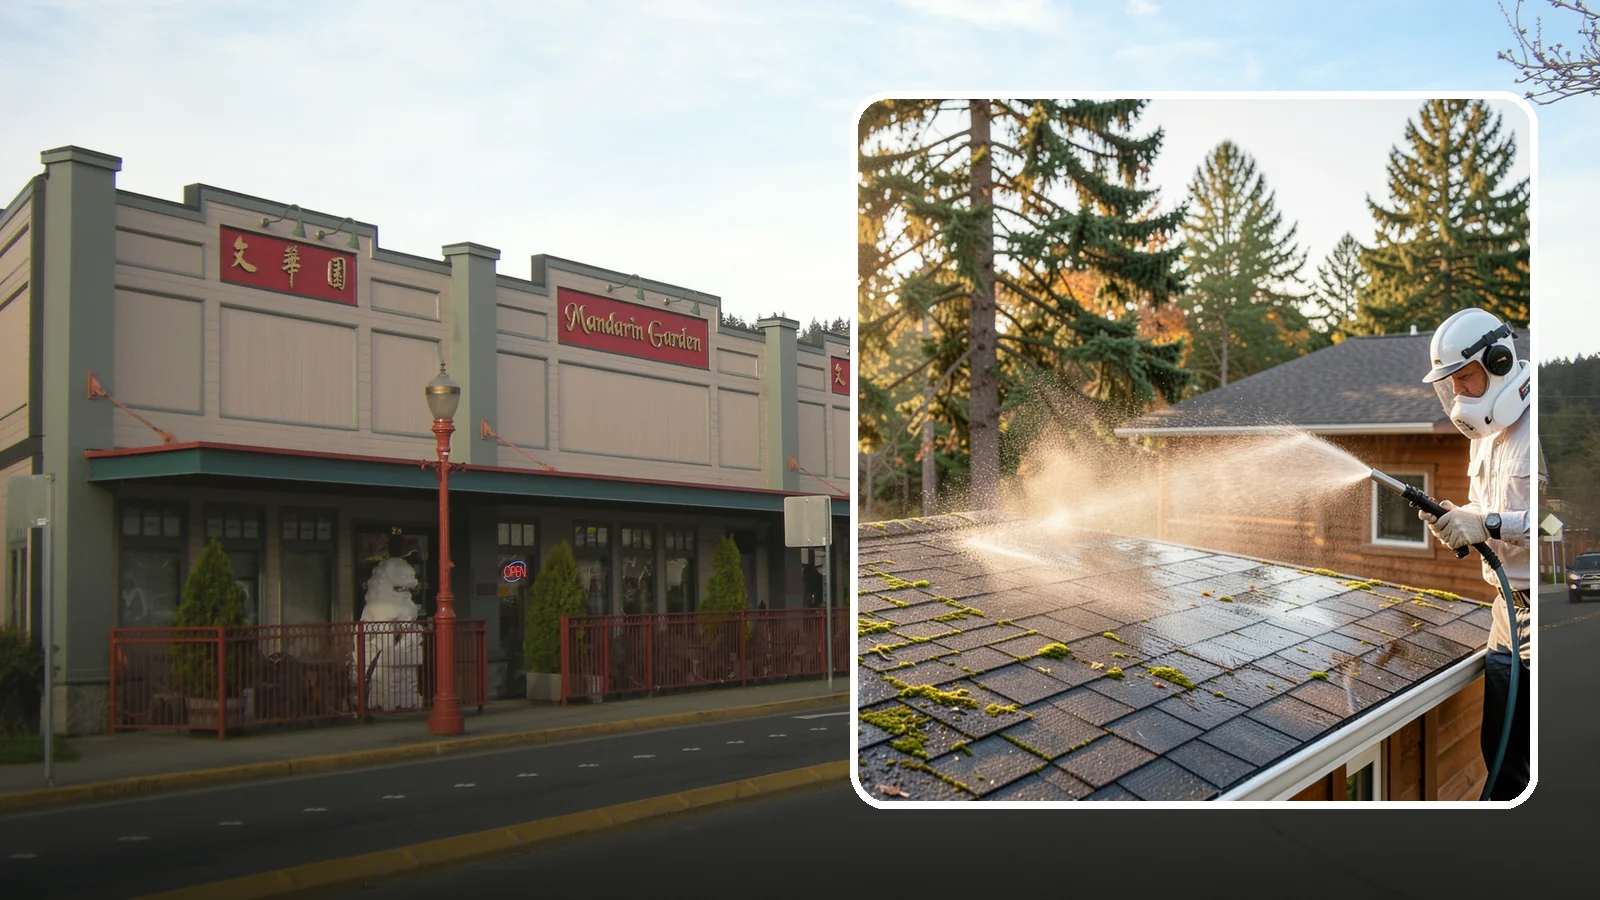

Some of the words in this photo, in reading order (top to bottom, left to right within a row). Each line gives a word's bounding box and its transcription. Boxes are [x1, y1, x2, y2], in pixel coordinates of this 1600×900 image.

[231, 236, 346, 290] 文華園
[564, 302, 643, 340] Mandarin
[648, 320, 701, 352] Garden
[503, 565, 527, 578] OPEN
